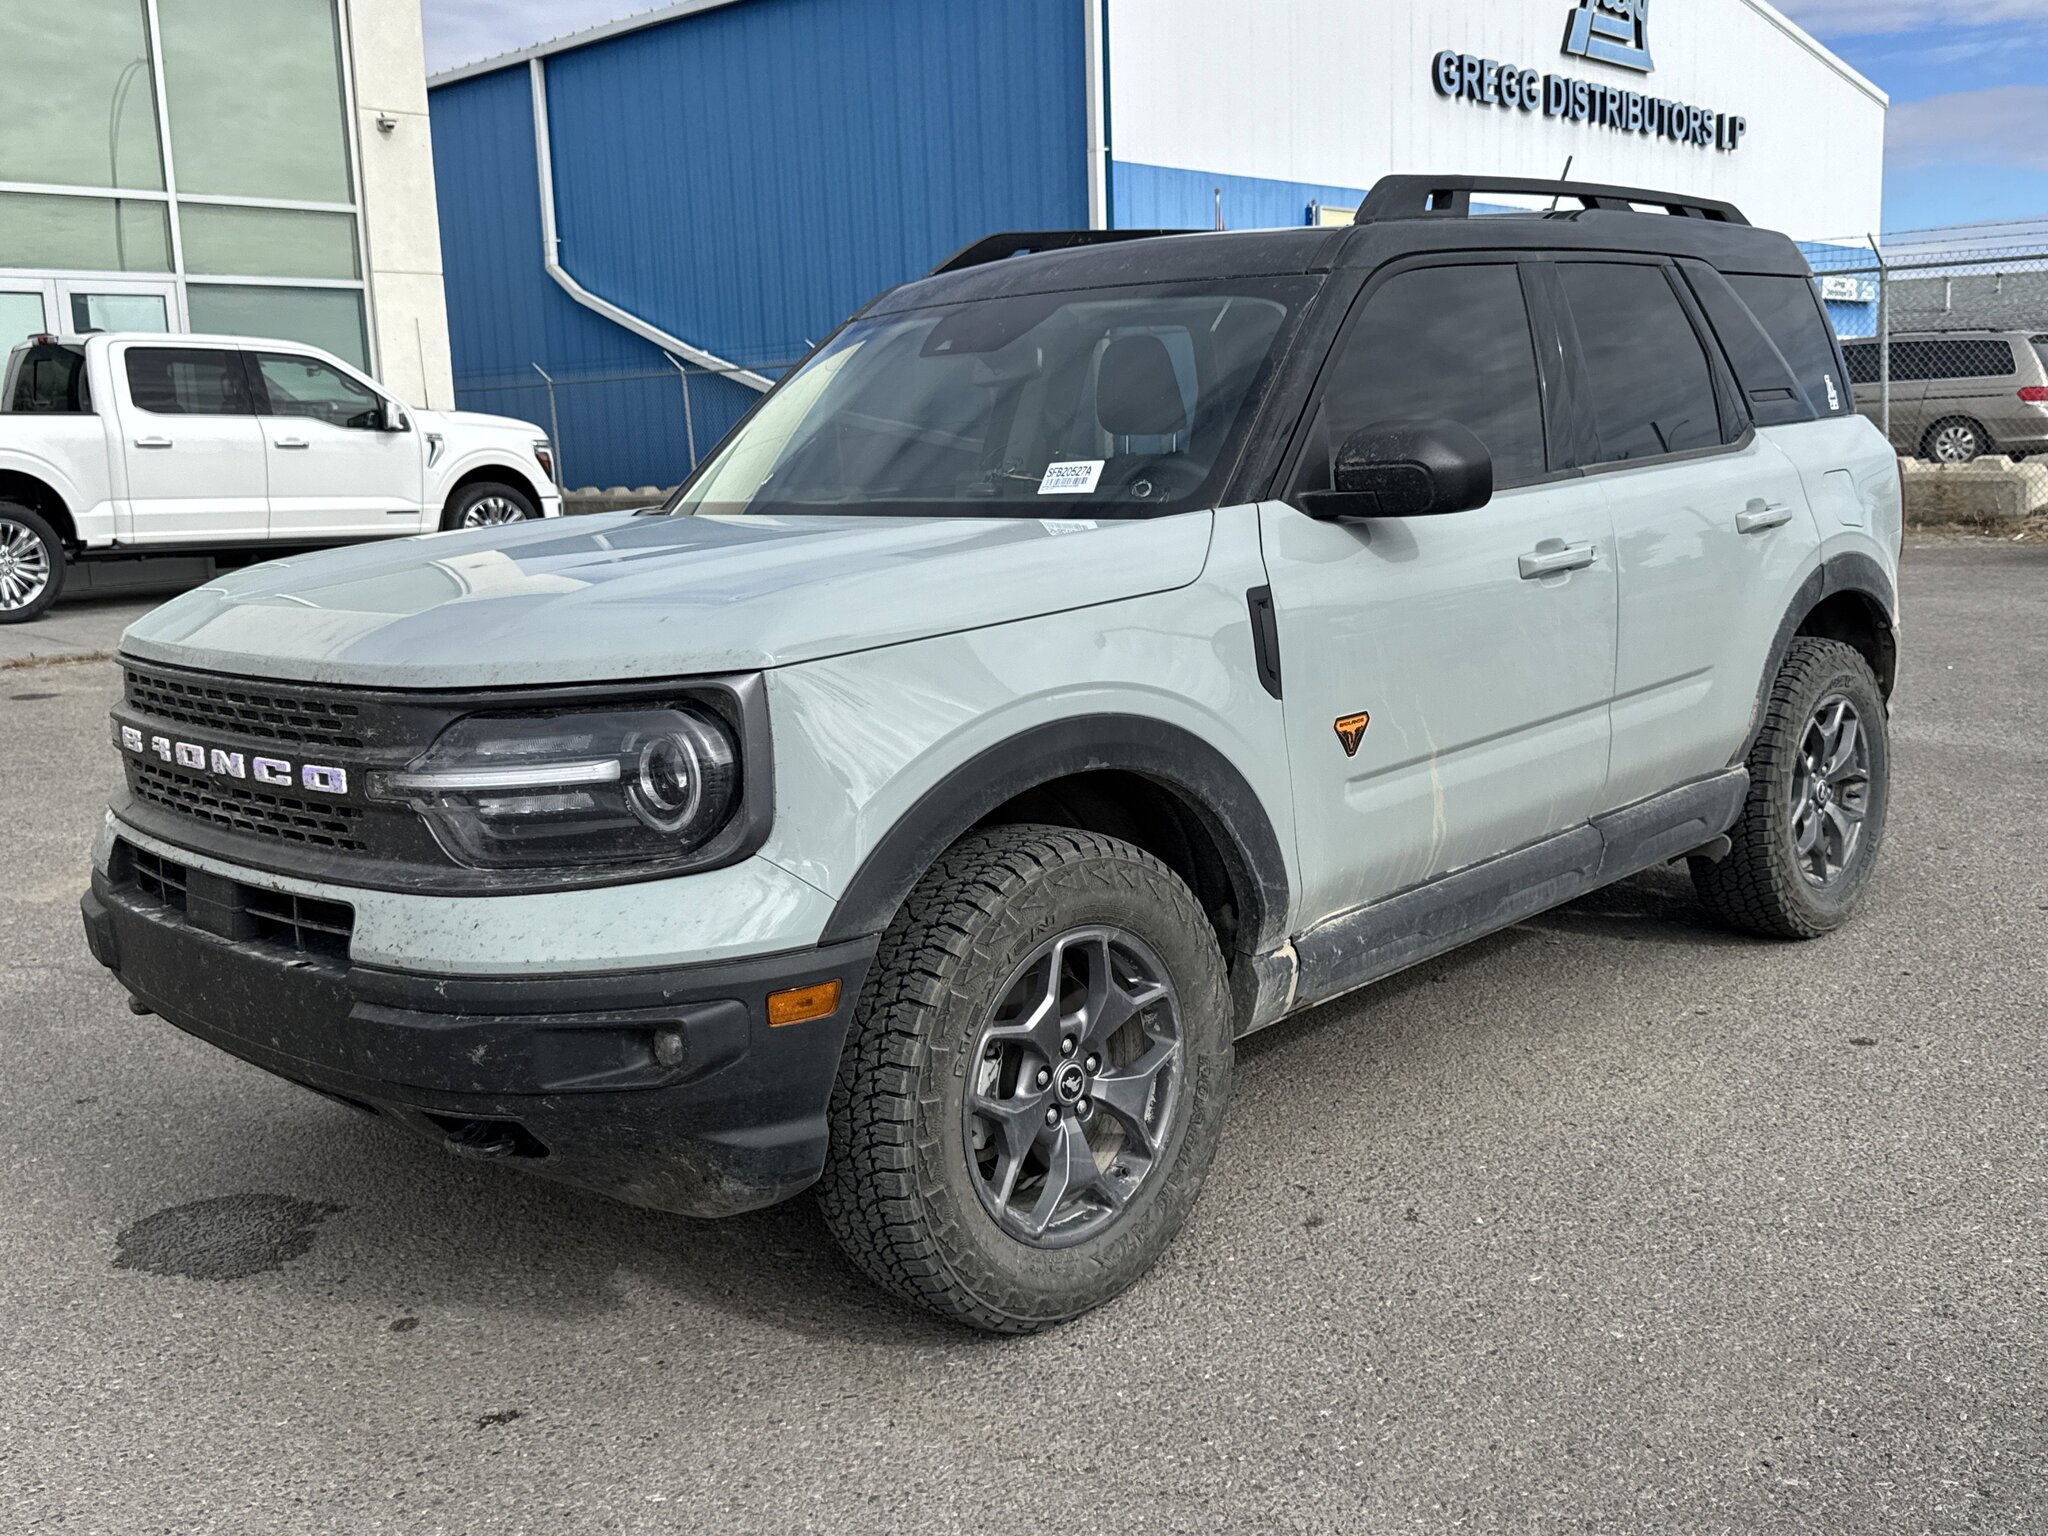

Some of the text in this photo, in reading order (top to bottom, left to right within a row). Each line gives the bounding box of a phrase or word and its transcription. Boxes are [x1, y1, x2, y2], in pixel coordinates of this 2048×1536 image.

[1432, 50, 1747, 151] GREGG DISTRIBUTORS LP
[121, 725, 348, 794] BRONCO
